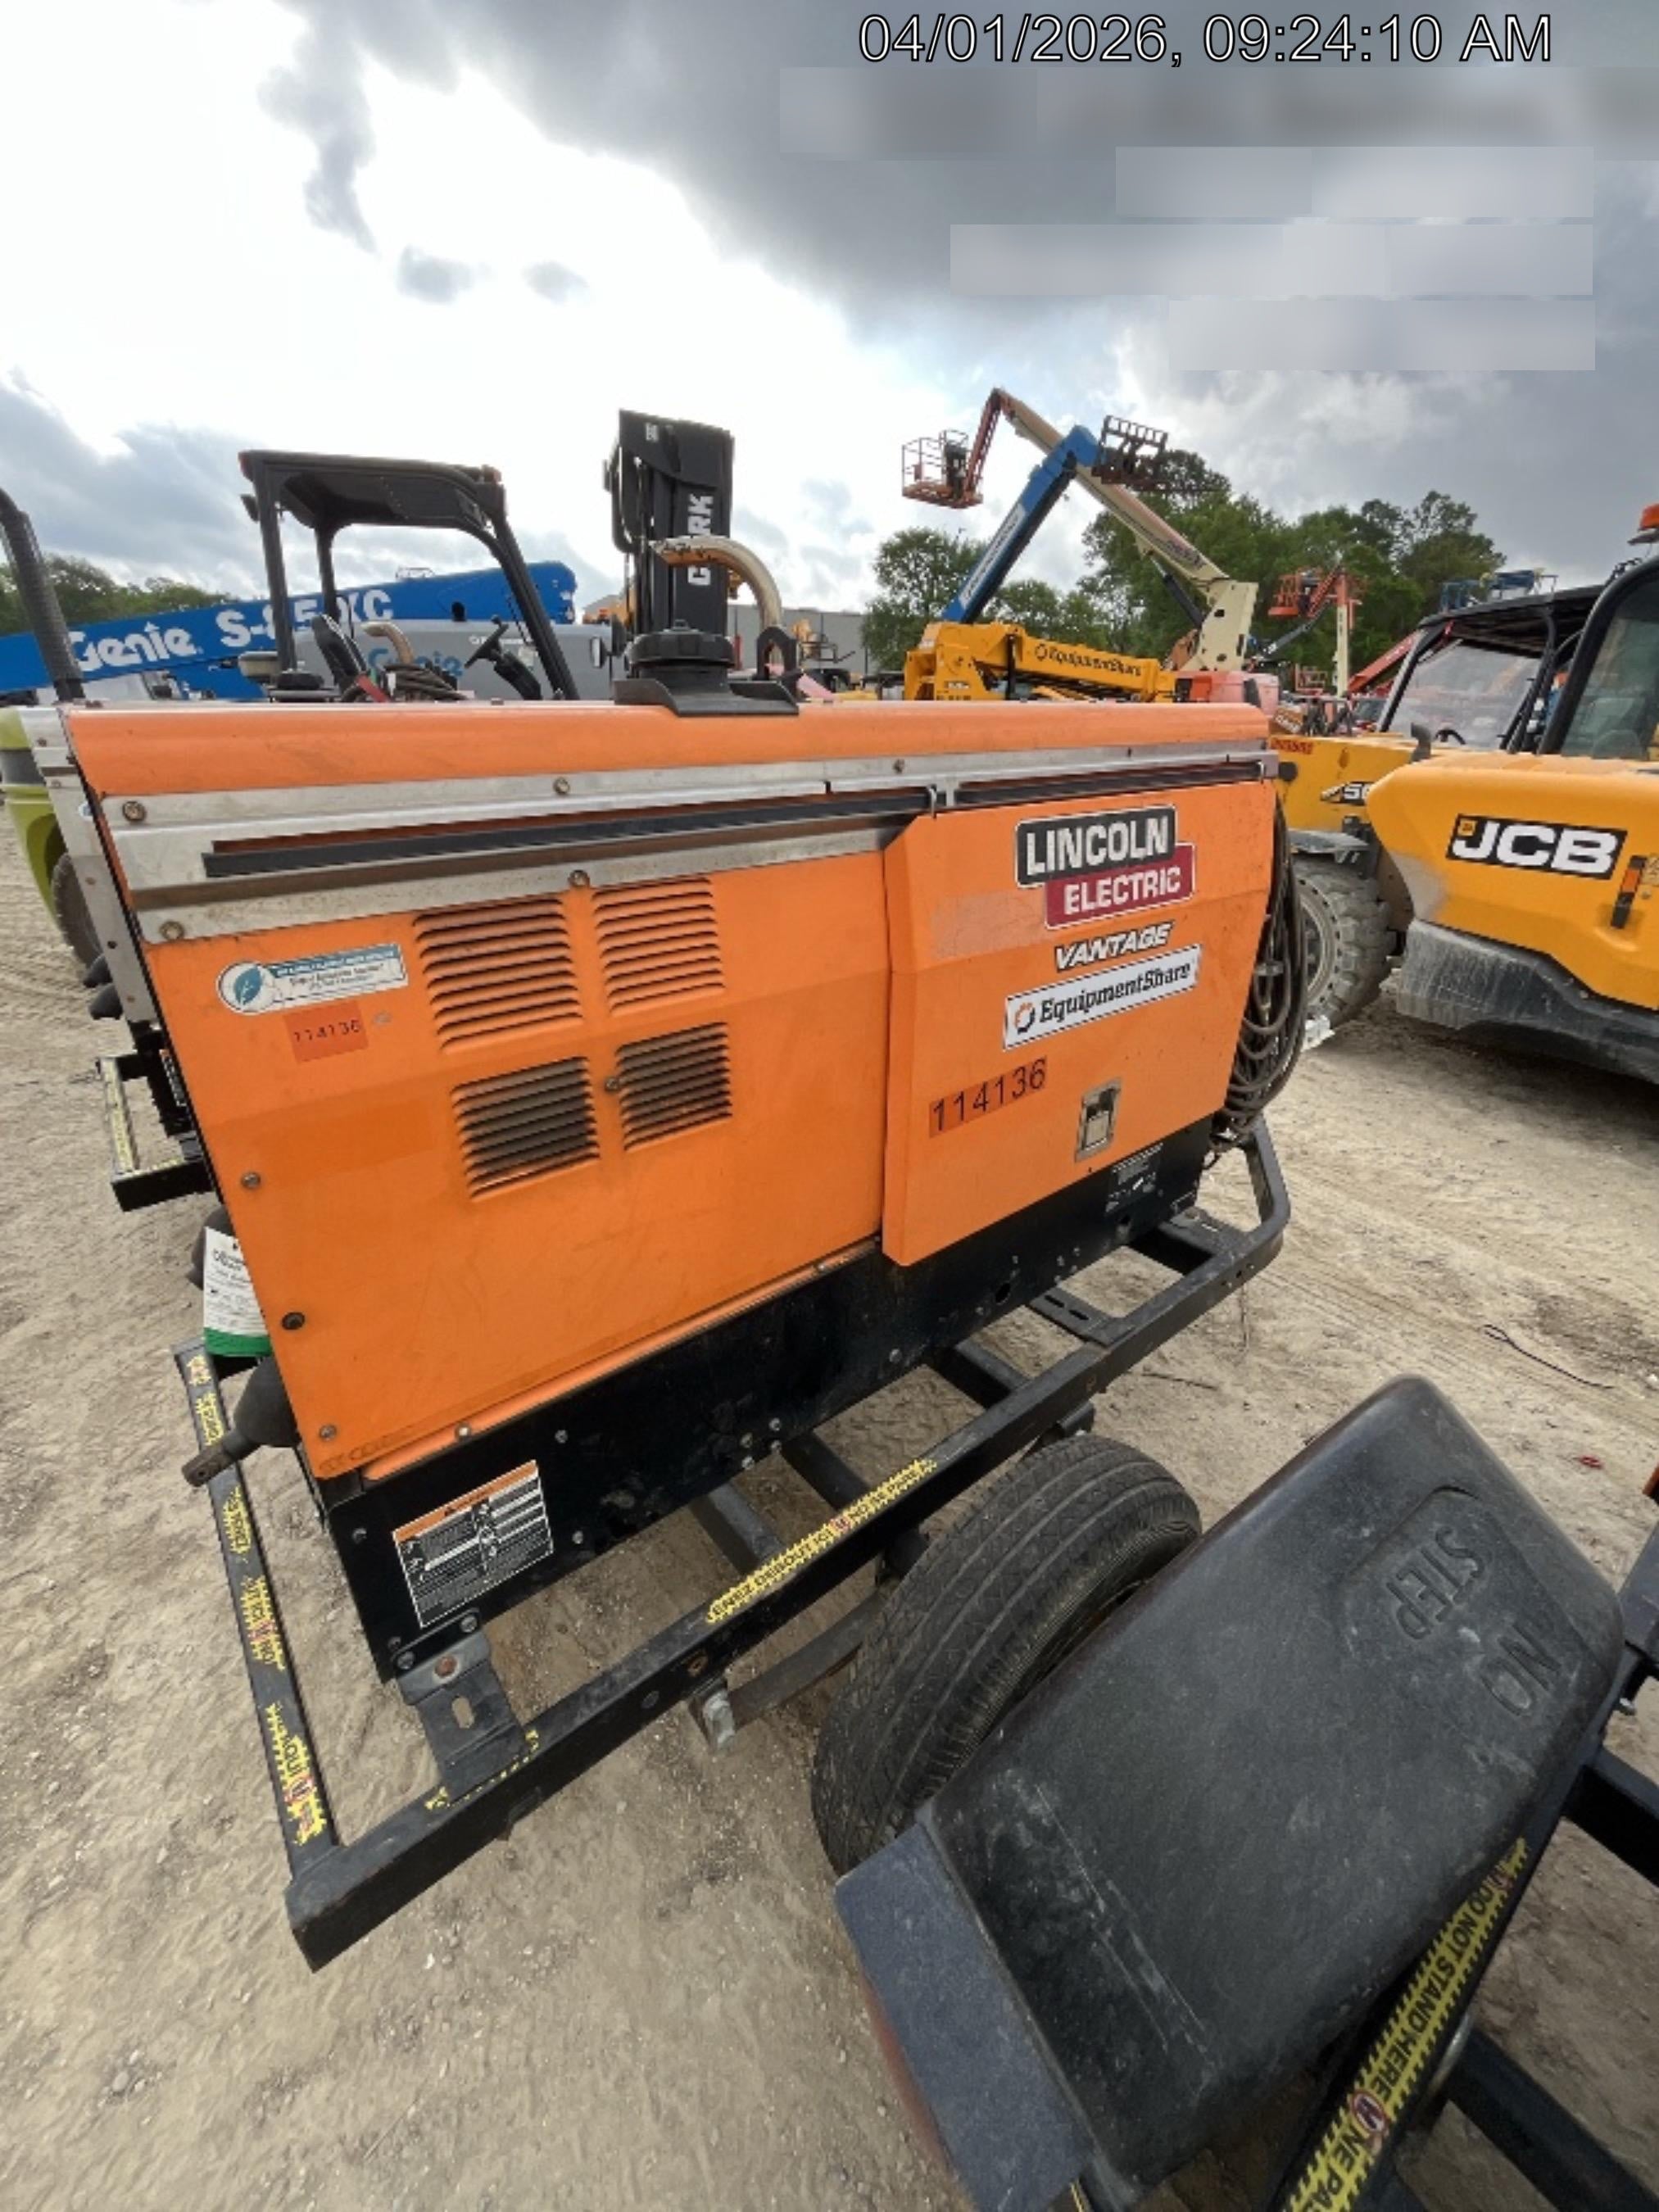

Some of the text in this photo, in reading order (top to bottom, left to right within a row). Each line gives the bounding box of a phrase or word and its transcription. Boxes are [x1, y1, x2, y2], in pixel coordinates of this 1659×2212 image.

[688, 493, 714, 586] CRK
[67, 621, 197, 672] Genie
[1025, 816, 1169, 877] LINCOLN
[1452, 820, 1618, 874] JCB
[1063, 866, 1181, 916] ELECTRIC
[1055, 921, 1175, 972] VANTAGE
[1039, 962, 1191, 1024] EquipmentShare
[932, 1058, 1046, 1132] 114136
[1385, 1525, 1485, 1639] STEP
[1480, 1624, 1562, 1716] NO
[1452, 1913, 1481, 1950] NOT
[1408, 1954, 1457, 2034] STAND
[1373, 2030, 1414, 2097] HERE
